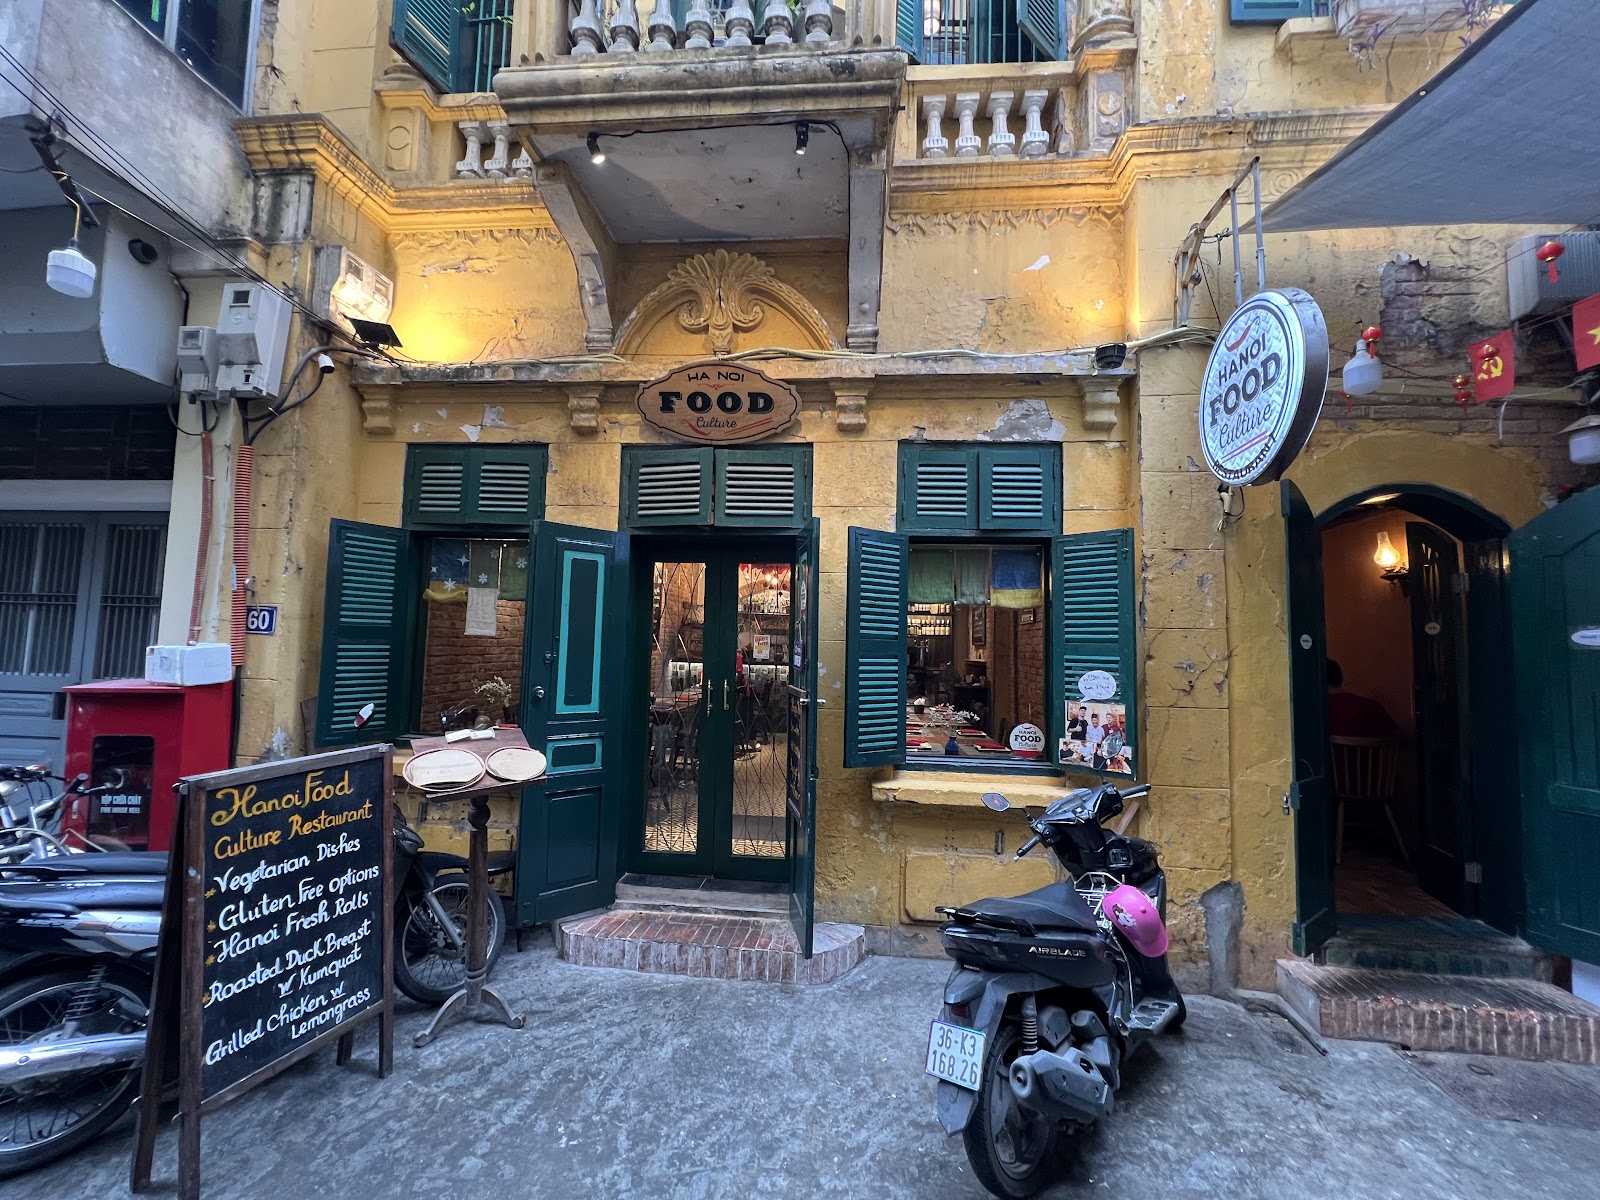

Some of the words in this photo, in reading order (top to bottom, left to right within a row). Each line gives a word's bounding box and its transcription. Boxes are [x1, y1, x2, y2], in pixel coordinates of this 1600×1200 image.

[687, 371, 711, 382] HA
[717, 371, 745, 383] NOI
[1218, 332, 1266, 387] HANOI
[658, 391, 775, 415] FOOD
[1209, 352, 1281, 429] FOOD
[696, 416, 737, 429] Culture
[1219, 403, 1272, 449] Culture
[1212, 431, 1277, 480] RESTAURANT
[247, 610, 270, 630] 60
[1014, 734, 1041, 743] FOOD
[211, 784, 301, 827] Hanoi
[301, 770, 354, 809] Food
[214, 828, 282, 860] Culture
[288, 798, 373, 841] Restaurant
[213, 855, 310, 894] Vegetarian
[316, 832, 361, 862] Dishes
[213, 923, 281, 963] Hanoi
[285, 900, 331, 936] Fresh
[333, 891, 369, 919] Rolls
[218, 893, 295, 932] Gluten
[298, 876, 324, 904] Free
[204, 956, 284, 1008] Roasted
[324, 918, 372, 955] Breast
[299, 942, 362, 990] Kumquat
[1029, 946, 1086, 957] AIRBLADE
[291, 987, 371, 1040] Lemongrass
[205, 1018, 265, 1066] Grilled
[937, 1026, 977, 1057] 36-K3
[931, 1050, 978, 1086] 168.26
